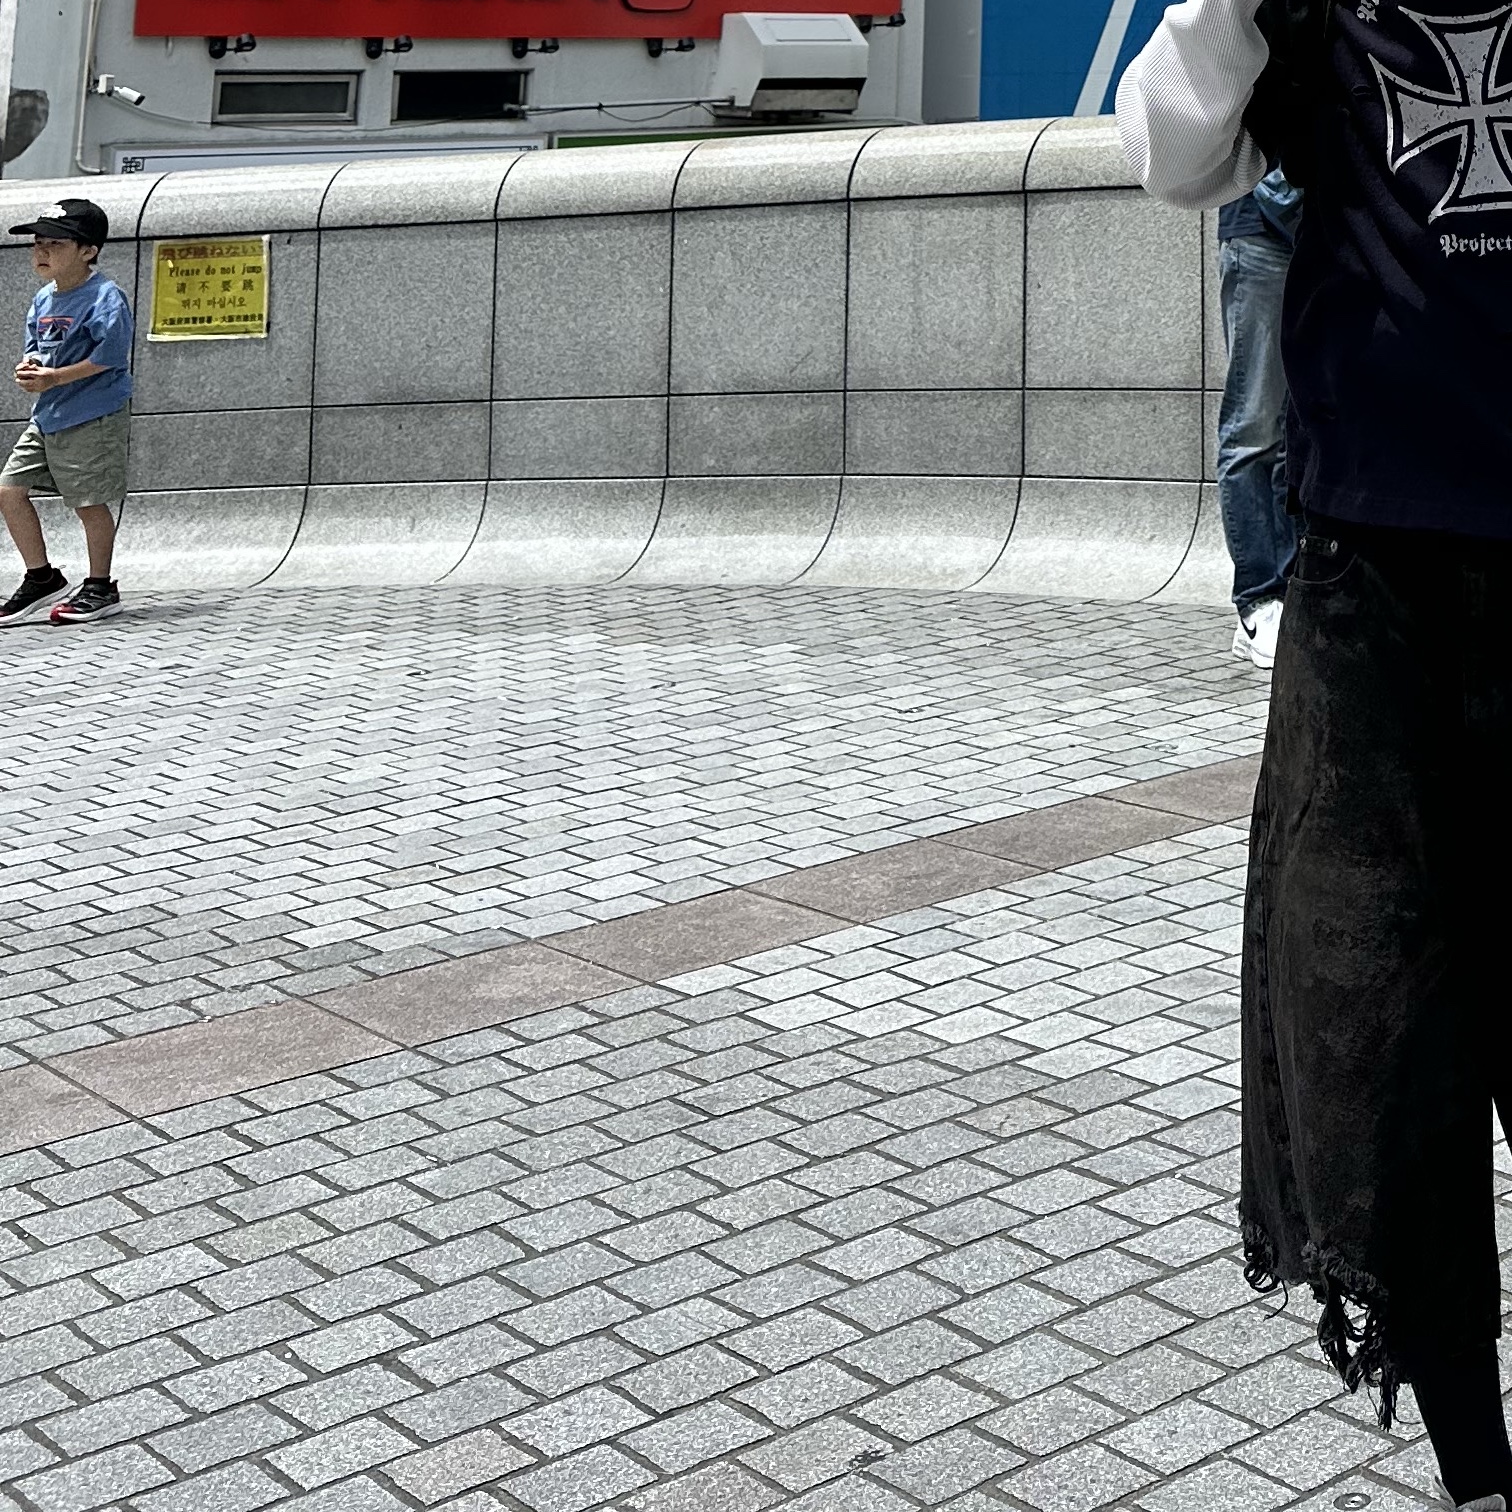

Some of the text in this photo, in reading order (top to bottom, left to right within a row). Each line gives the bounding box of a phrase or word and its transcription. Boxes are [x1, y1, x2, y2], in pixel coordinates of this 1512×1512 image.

[169, 266, 200, 277] Please
[205, 265, 216, 275] do
[242, 264, 262, 275] jump
